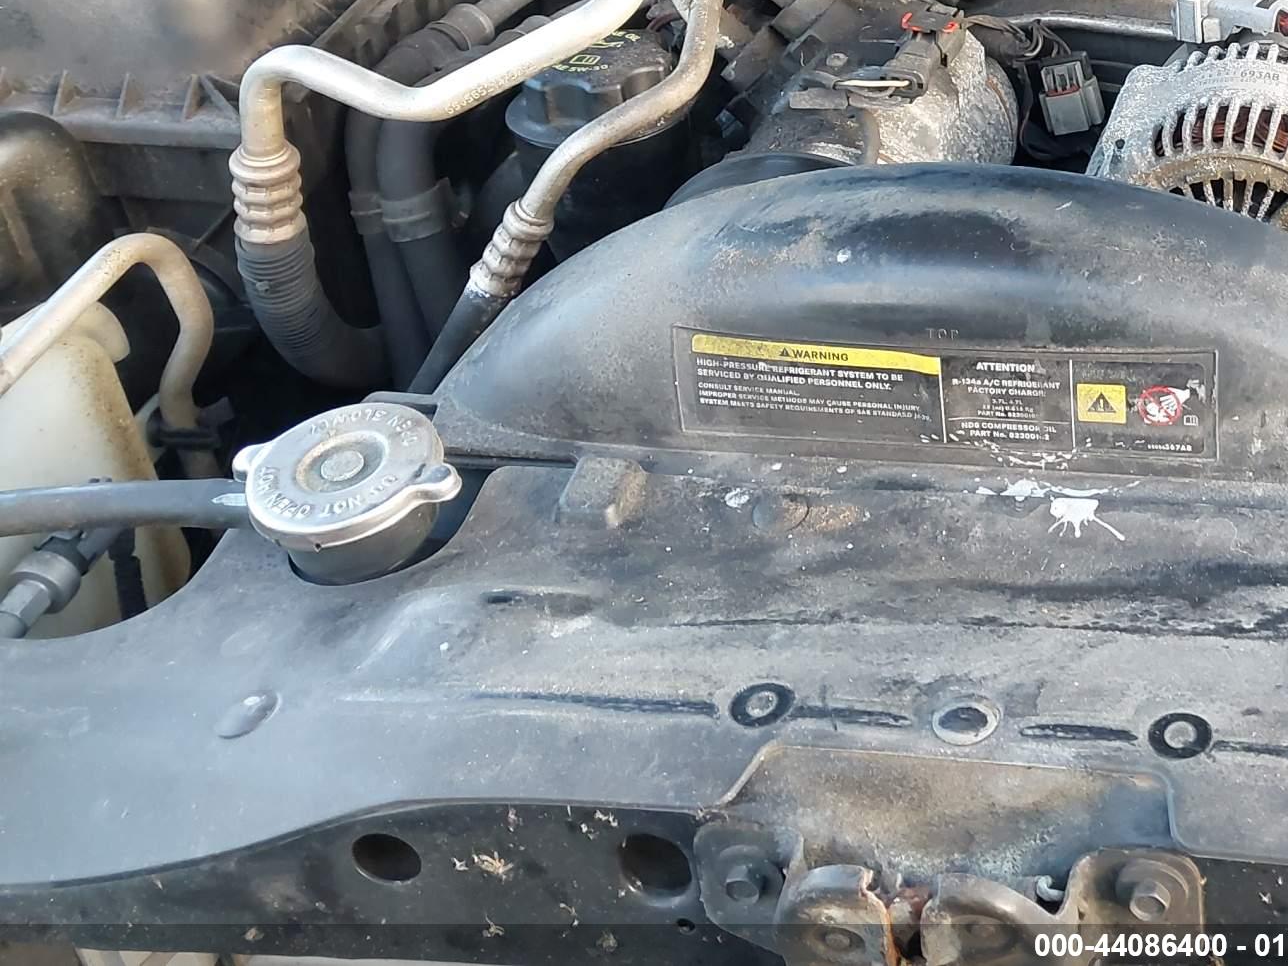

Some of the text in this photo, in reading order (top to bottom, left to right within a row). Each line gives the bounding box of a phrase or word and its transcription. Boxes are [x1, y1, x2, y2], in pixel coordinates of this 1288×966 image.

[925, 327, 960, 341] TOP
[792, 349, 849, 362] WARNING
[697, 357, 904, 382] HIGH-PRESSURE REFRIGERANT SYSTEM TO BE
[975, 361, 1035, 373] ATTENTION
[697, 368, 892, 390] SERVICED BY QUALIFIED PERSONNEL ONLY.
[951, 377, 982, 386] R-134a
[983, 378, 1001, 387] A/C
[698, 381, 732, 391] CONSULT
[967, 386, 1007, 395] FACTORY
[699, 389, 737, 399] IMPROPER
[808, 397, 825, 405] MAY
[826, 399, 852, 408] CAUSE
[852, 401, 893, 410] PERSONAL
[981, 422, 1041, 432] COMPRESSOR
[969, 429, 991, 437] PART
[1008, 430, 1050, 440] 8230012
[265, 491, 312, 519] OPEN
[321, 494, 368, 519] NOT
